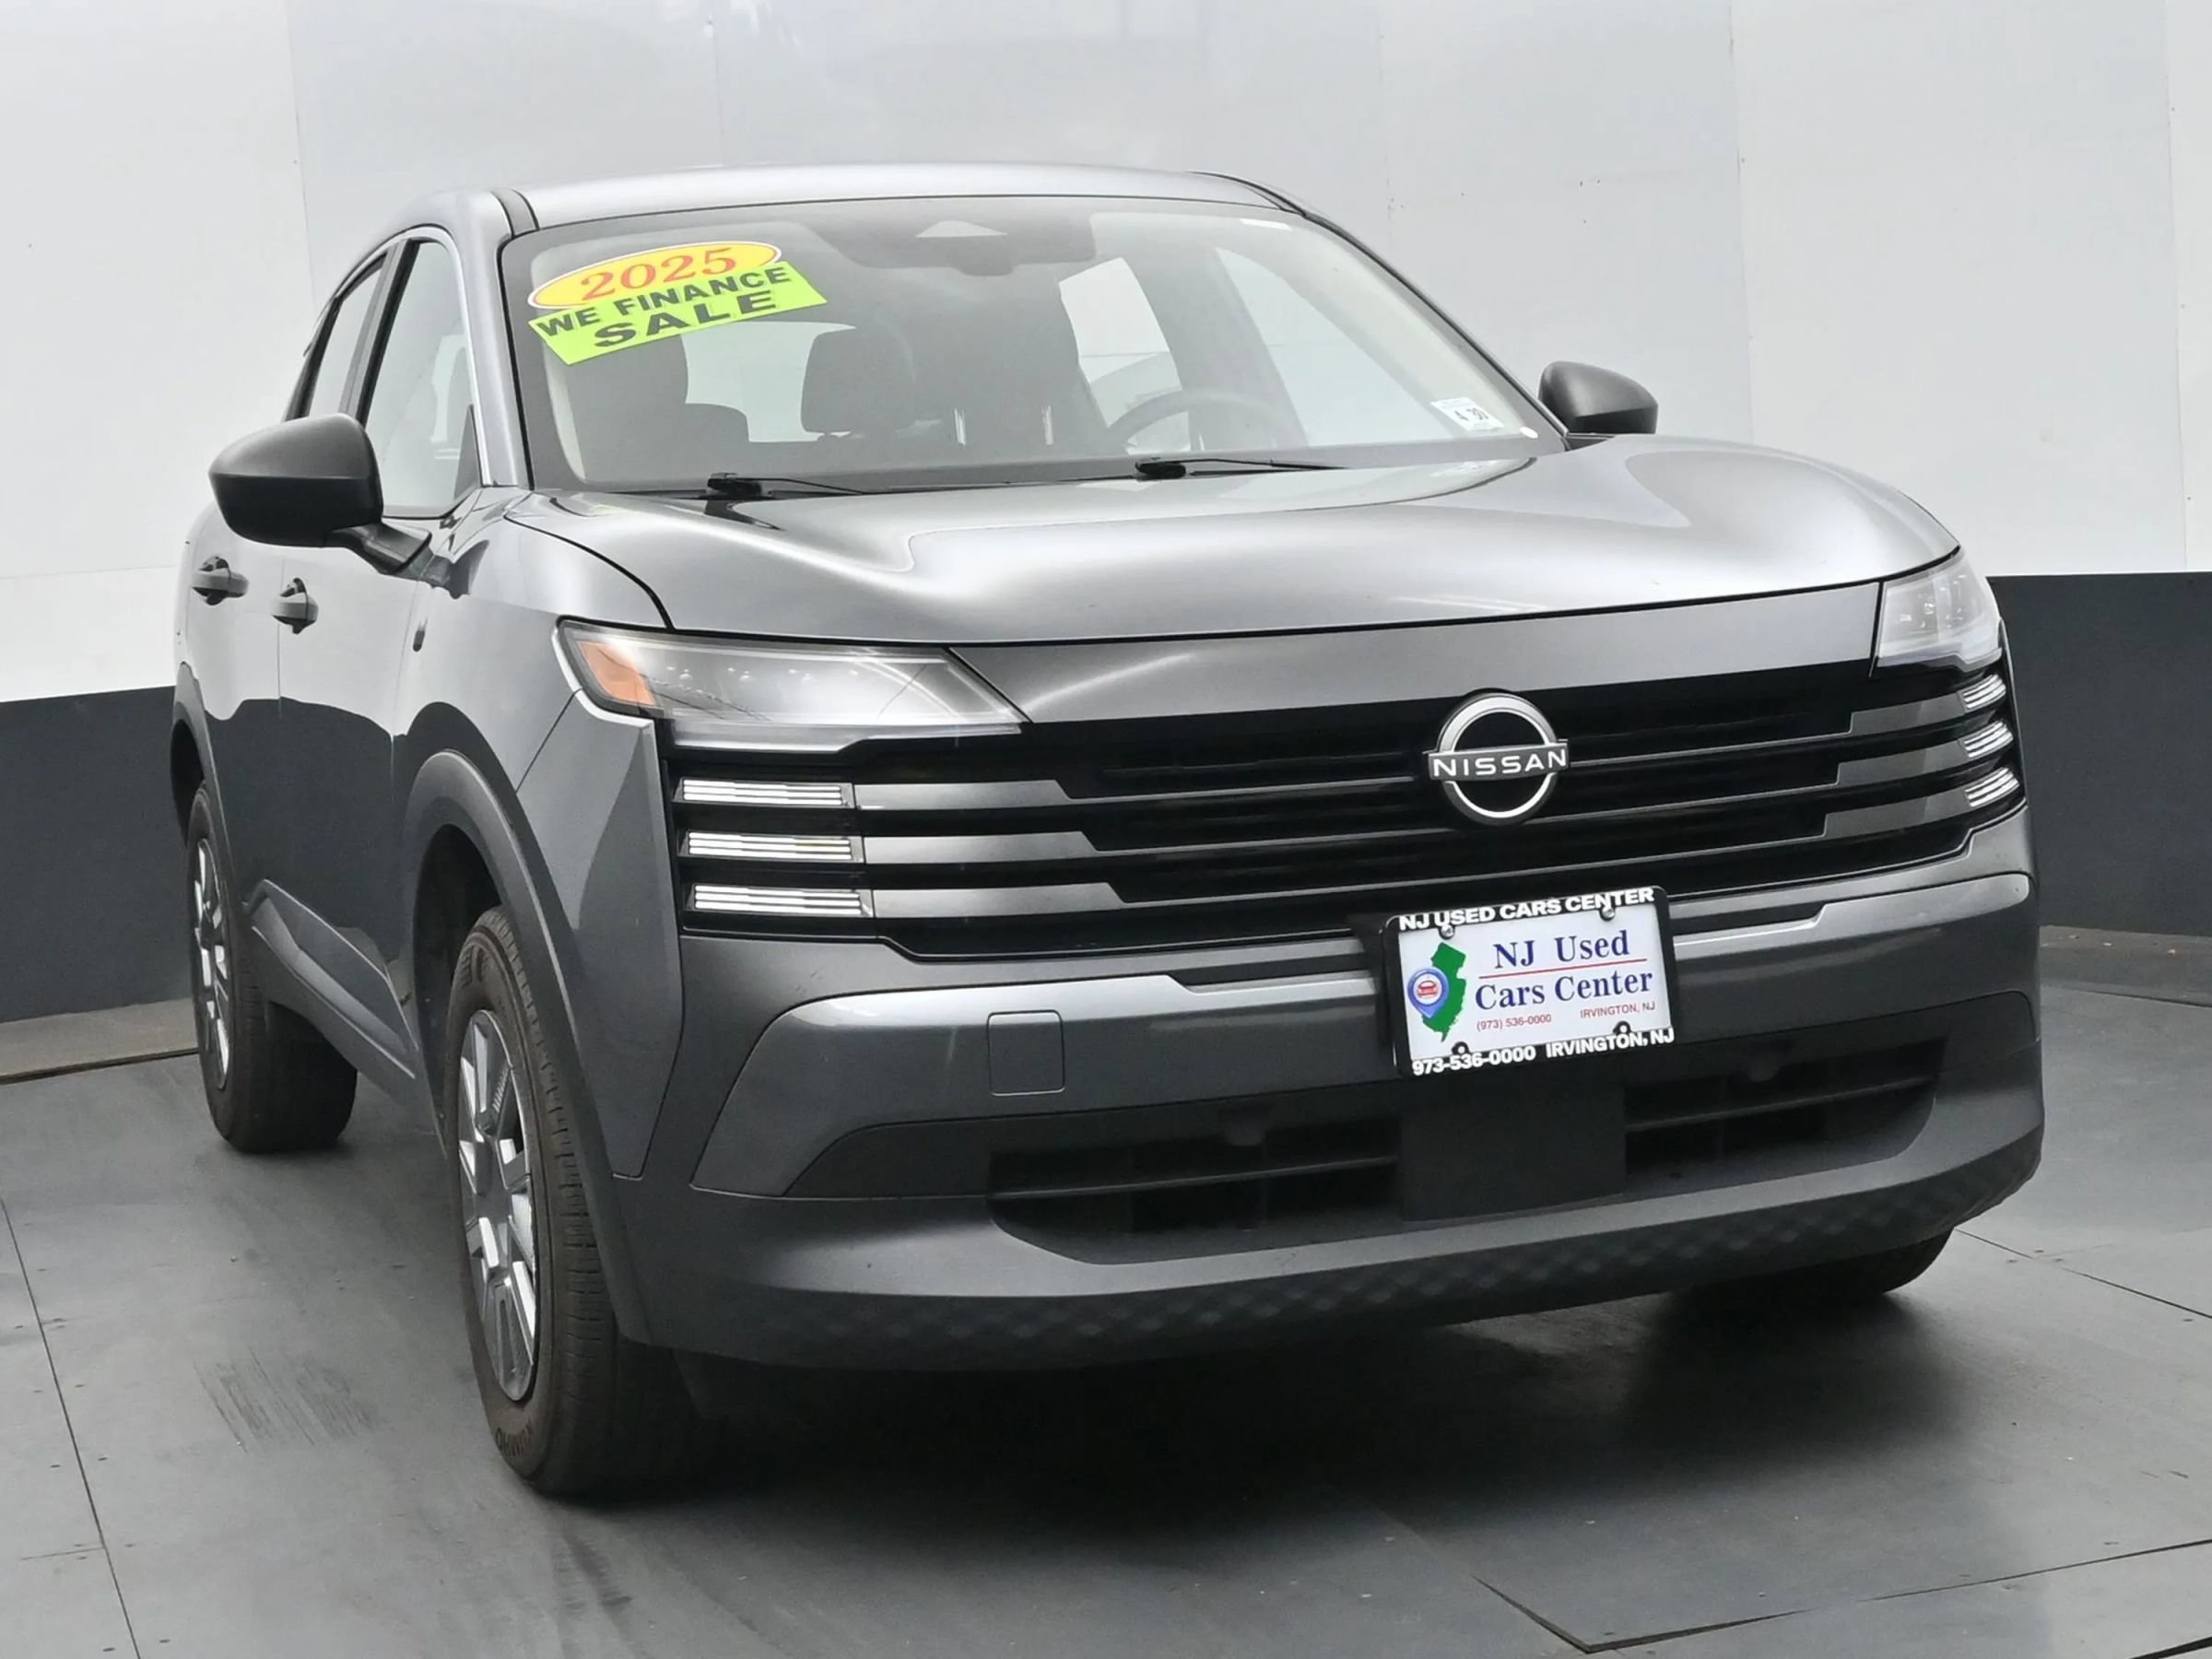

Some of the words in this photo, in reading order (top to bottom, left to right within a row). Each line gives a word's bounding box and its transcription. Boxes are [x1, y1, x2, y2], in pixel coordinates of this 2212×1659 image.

[581, 247, 736, 301] 2025
[537, 307, 600, 336] WE
[613, 267, 792, 316] FINANCE
[594, 290, 776, 347] SALE
[1433, 749, 1567, 777] NISSAN
[1399, 913, 1430, 931] NJ
[1434, 906, 1495, 926] USED
[1500, 899, 1561, 919] CARS
[1565, 887, 1655, 912] CENTER
[1493, 940, 1535, 970] NJ
[1554, 929, 1630, 962] Used
[1476, 983, 1546, 1010] Cars
[1555, 971, 1653, 1002] Center
[1477, 1018, 1503, 1032] (973)
[1506, 1014, 1552, 1028] 536-0000
[1580, 1005, 1640, 1018] IRVINGTON,
[1642, 1001, 1655, 1011] NJ
[1412, 1045, 1536, 1077] 973-536-0000
[1546, 1032, 1648, 1058] IRVINGTON,
[1651, 1026, 1675, 1044] NJ
